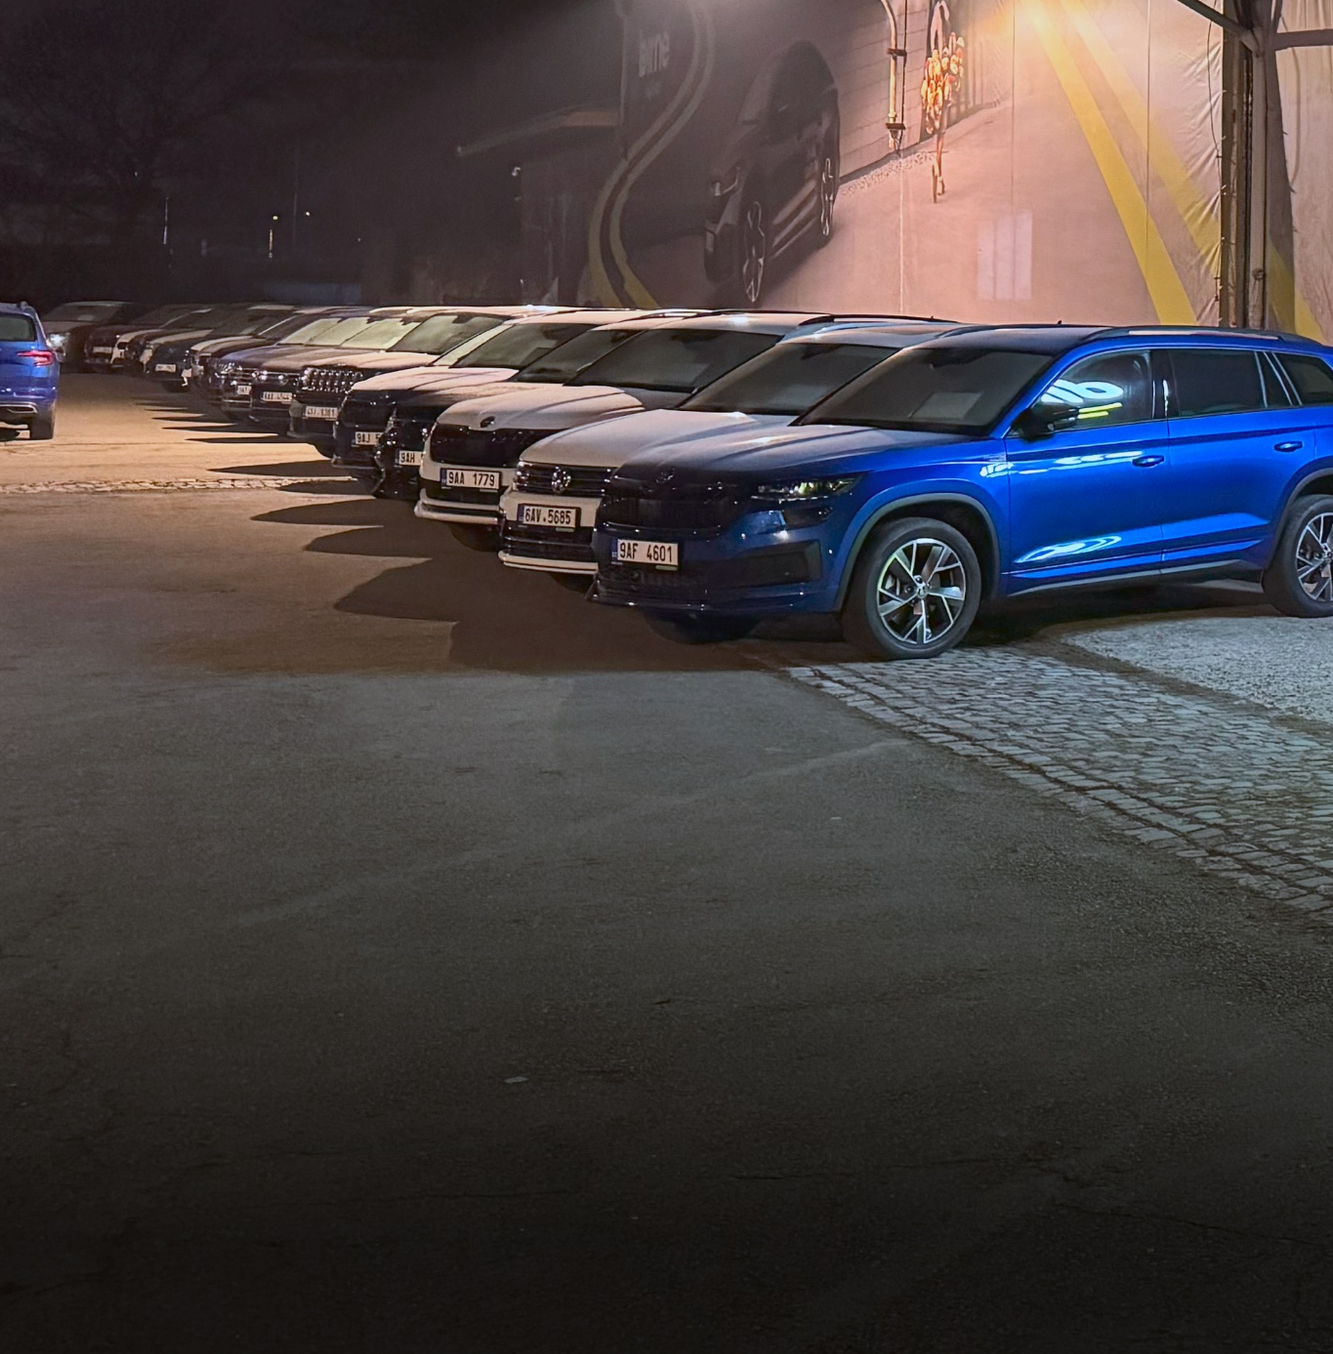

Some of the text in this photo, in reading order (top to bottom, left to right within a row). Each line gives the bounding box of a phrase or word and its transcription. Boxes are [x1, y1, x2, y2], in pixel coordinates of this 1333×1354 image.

[448, 471, 495, 487] 9AA 1779
[525, 508, 572, 525] 6AV 5685
[620, 542, 672, 563] 9AF 4601
